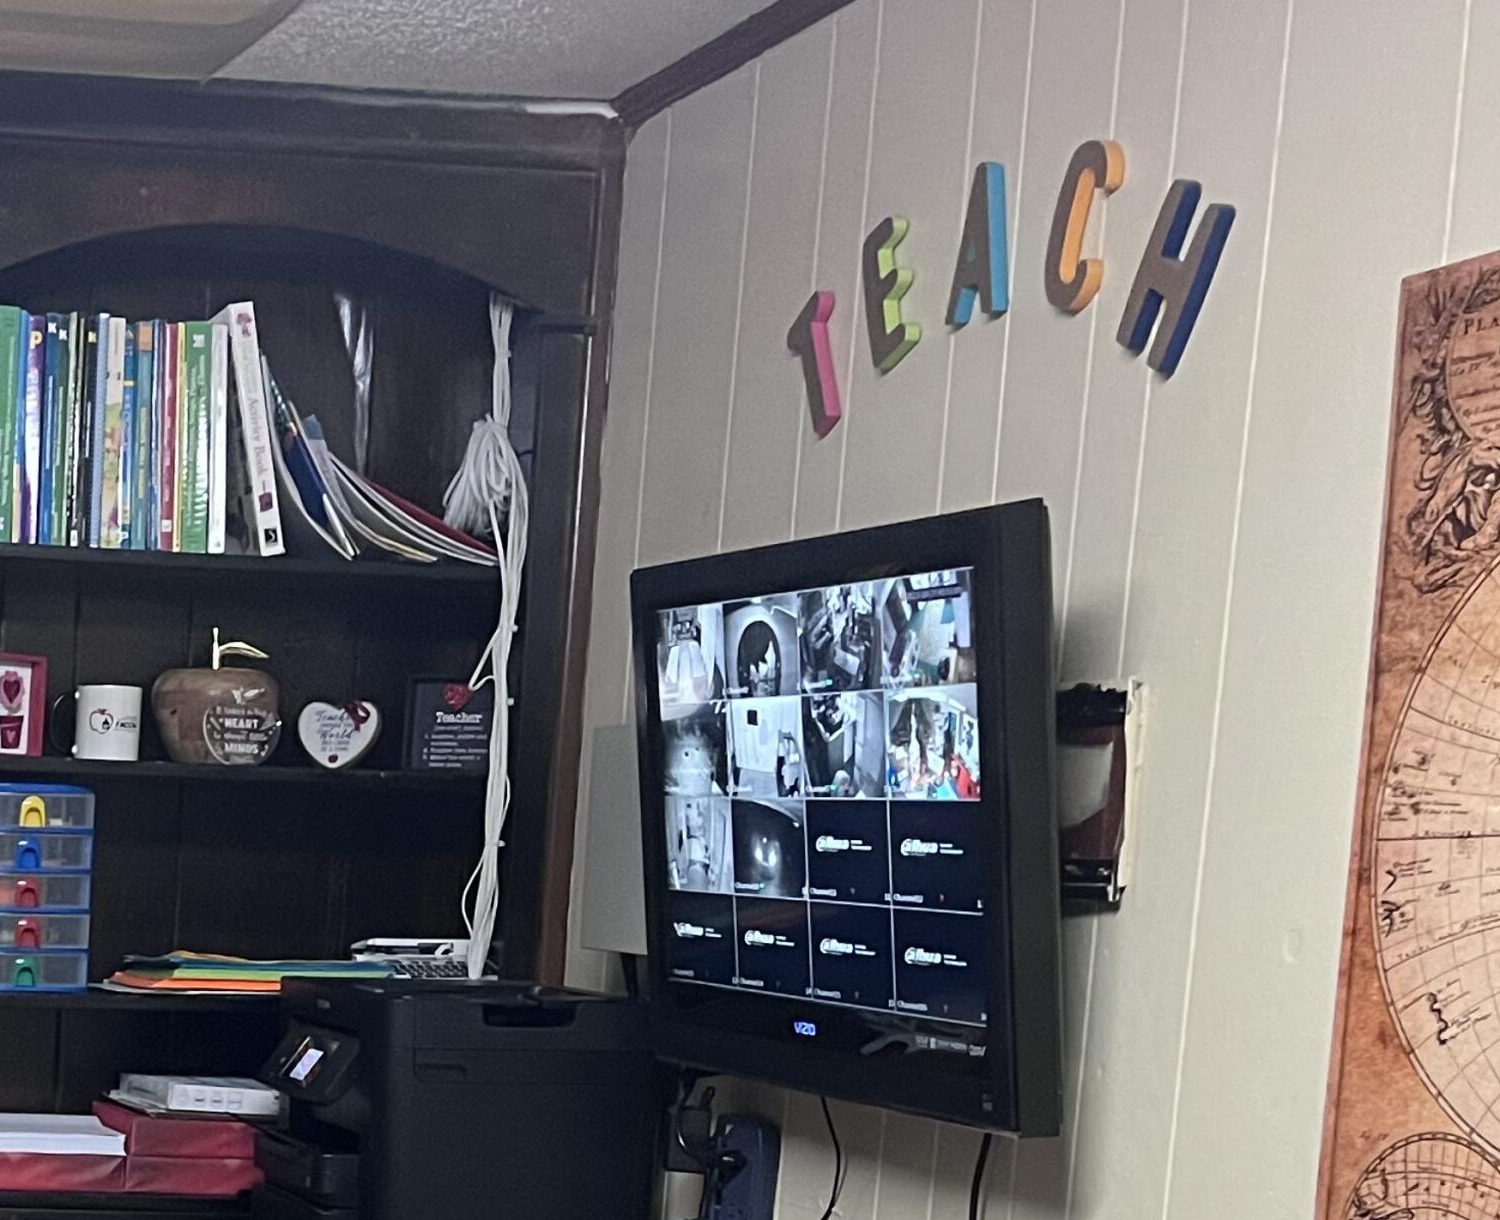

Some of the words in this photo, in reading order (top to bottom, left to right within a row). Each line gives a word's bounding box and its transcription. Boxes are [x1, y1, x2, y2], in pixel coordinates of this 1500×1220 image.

[787, 139, 1236, 440] TEACH
[224, 717, 259, 729] HEART
[436, 711, 483, 724] Teacher
